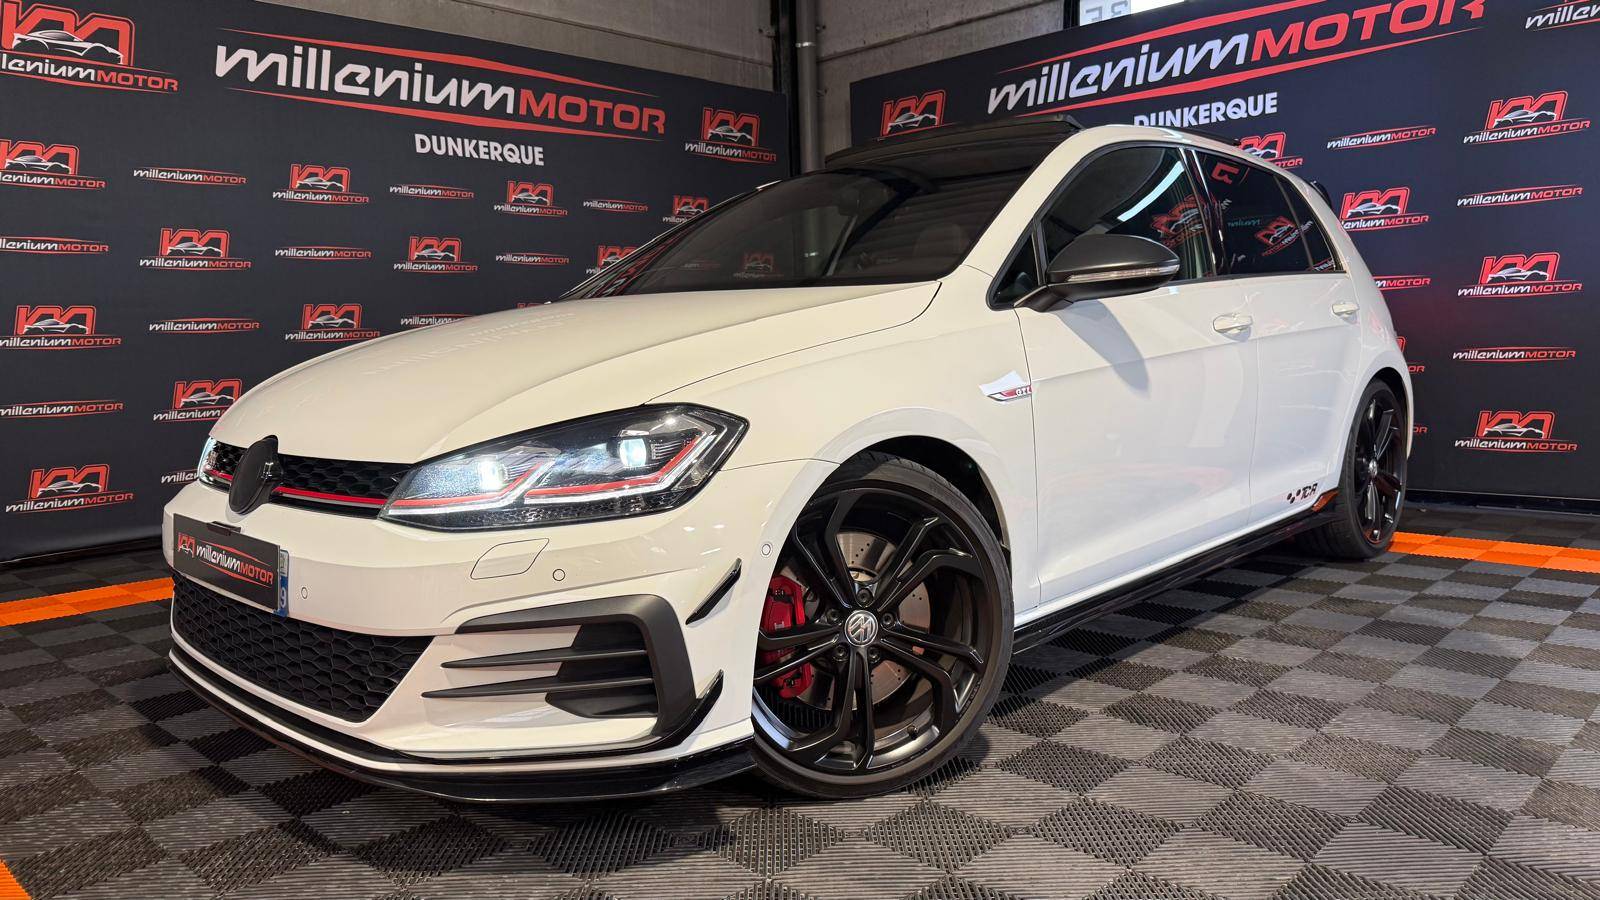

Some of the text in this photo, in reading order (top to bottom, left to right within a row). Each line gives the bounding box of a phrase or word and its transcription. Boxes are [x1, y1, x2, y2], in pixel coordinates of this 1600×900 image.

[987, 0, 1484, 114] milleniumMOTOR
[1, 53, 179, 92] leniumMOTOR
[216, 44, 666, 134] milleniumMOTOR
[1134, 92, 1278, 127] DUNKERQUE
[1327, 127, 1437, 149] milleniumMOTOR
[1463, 120, 1591, 144] milleniumMOTOR
[414, 134, 545, 166] DUNKERQUE
[685, 141, 777, 162] milleniumMOTOR
[134, 168, 247, 184] milleniumMOTOR
[272, 190, 369, 203] milleniumMOTOR
[390, 185, 474, 198] milleniumMOTOR
[1457, 186, 1583, 207] milleniumMOTOR
[494, 203, 568, 216] milleniumMOTOR
[583, 200, 648, 212] milleniumMOTOR
[275, 247, 372, 258] milleniumMOTOR
[496, 253, 569, 265] milleniumMOTOR
[139, 257, 251, 269] milleniumMOTOR
[393, 262, 478, 272] milleniumMOTOR
[1457, 282, 1583, 297] milleniumMOTOR
[149, 320, 260, 331] milleniumMOTOR
[285, 330, 380, 340] milleniumMOTOR
[1453, 349, 1576, 360] milleniumMOTOR
[153, 409, 222, 421] millenium
[1454, 438, 1578, 451] milleniumMOTOR
[5, 492, 134, 513] milleniumMOTOR
[196, 544, 274, 585] milleniumMOTOR
